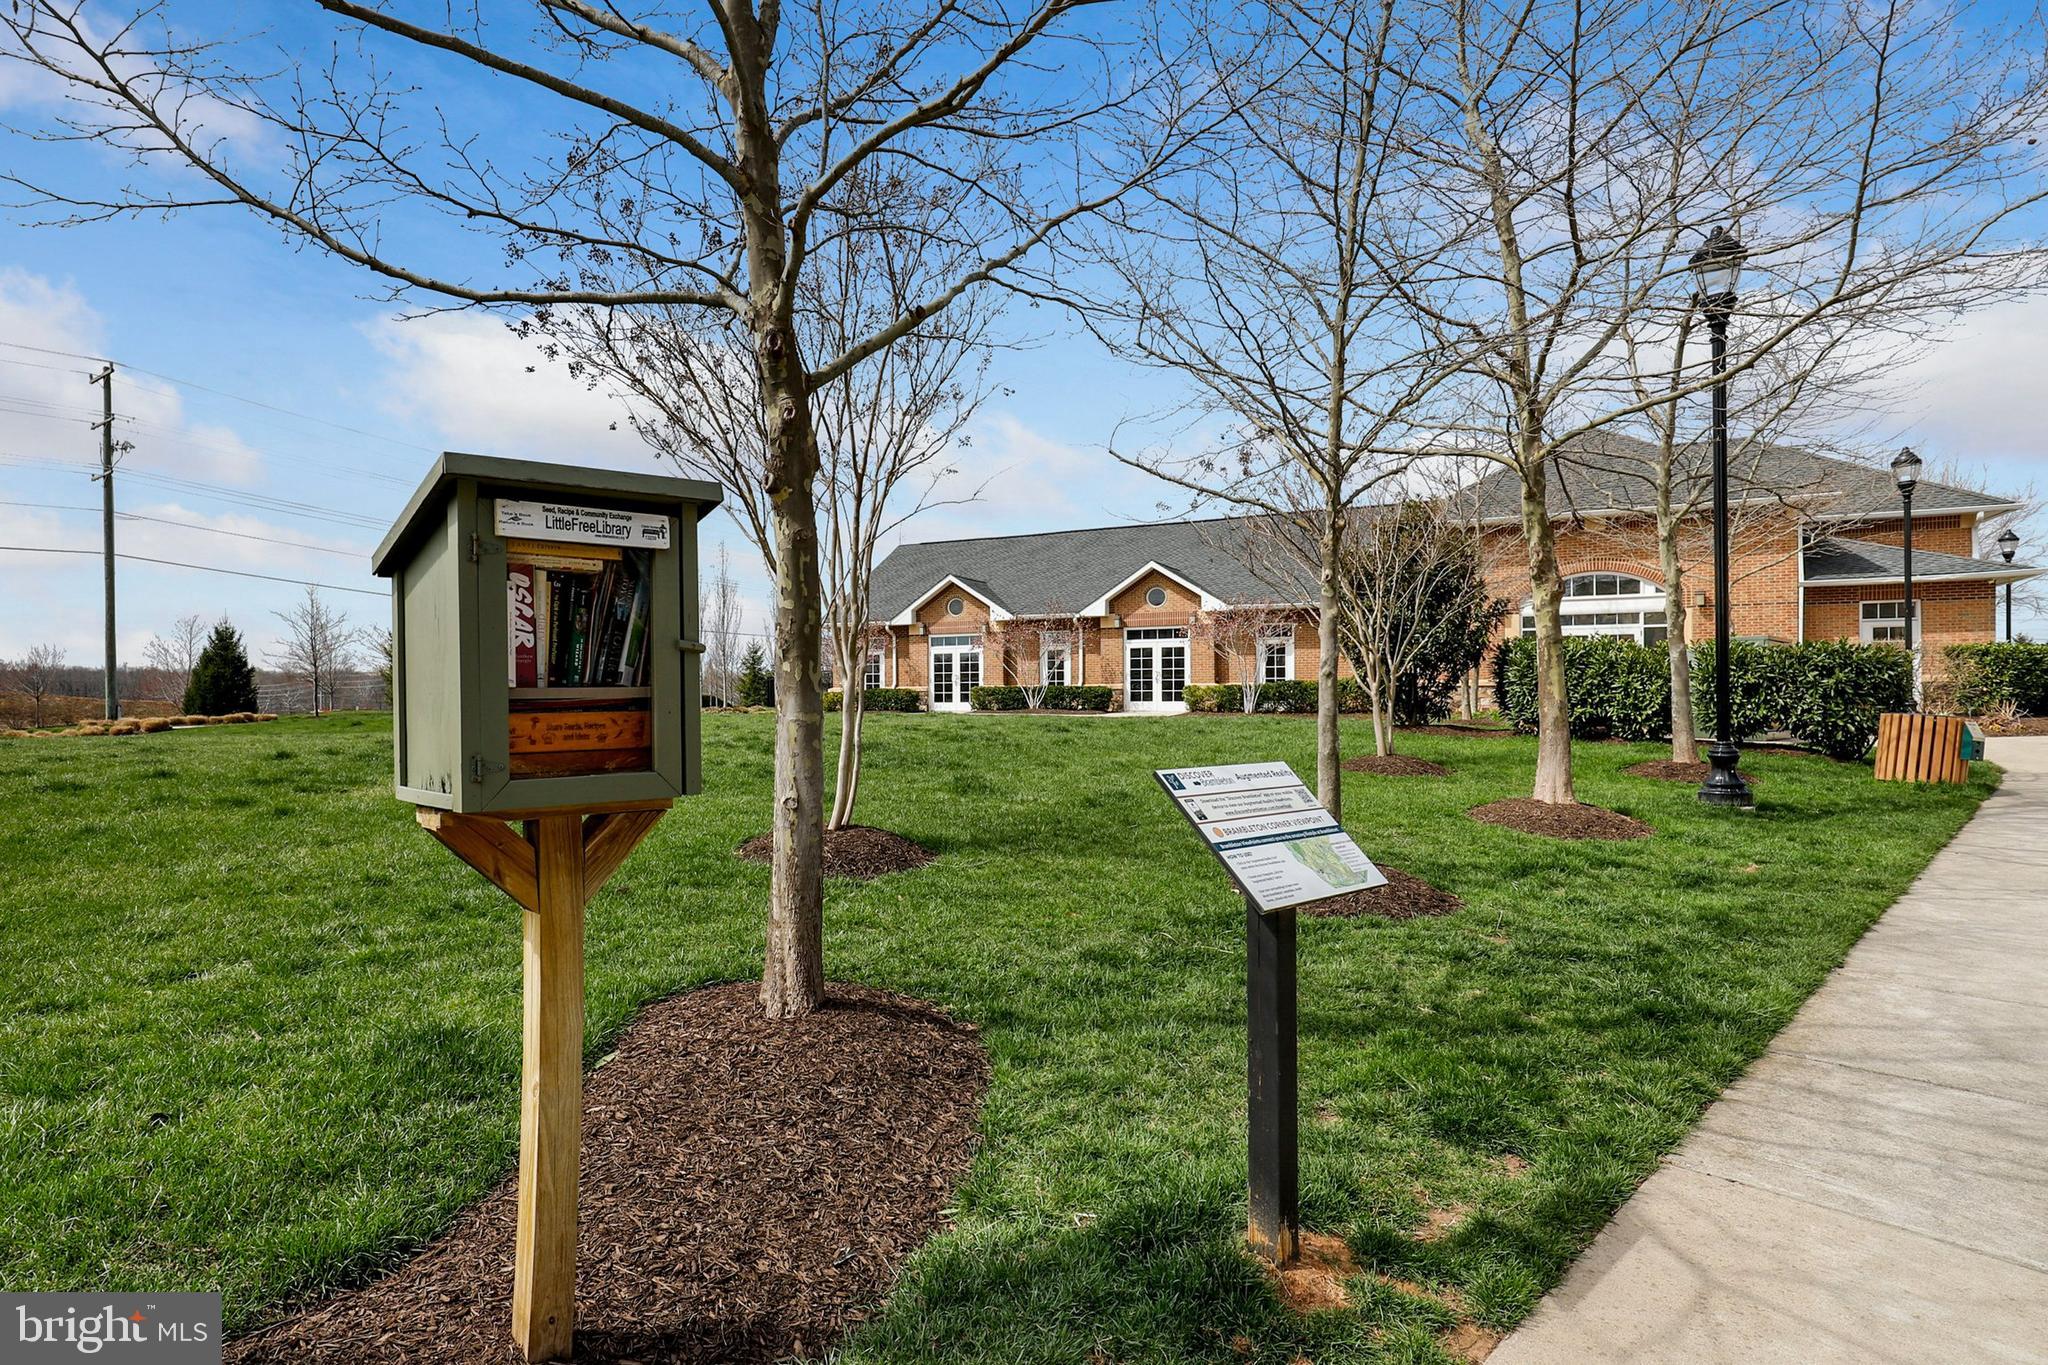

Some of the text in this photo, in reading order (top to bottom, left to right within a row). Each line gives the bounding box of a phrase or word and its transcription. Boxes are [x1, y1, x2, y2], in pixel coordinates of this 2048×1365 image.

[542, 505, 633, 522] Seed, Recipe & Community Exchange
[545, 515, 632, 539] LittleFreeLibrary
[1177, 768, 1294, 782] DISCOVER Augmented Reality
[1200, 776, 1236, 788] Brambleton
[1222, 815, 1324, 836] BRAMBLETON CORNER VIEWPOINT
